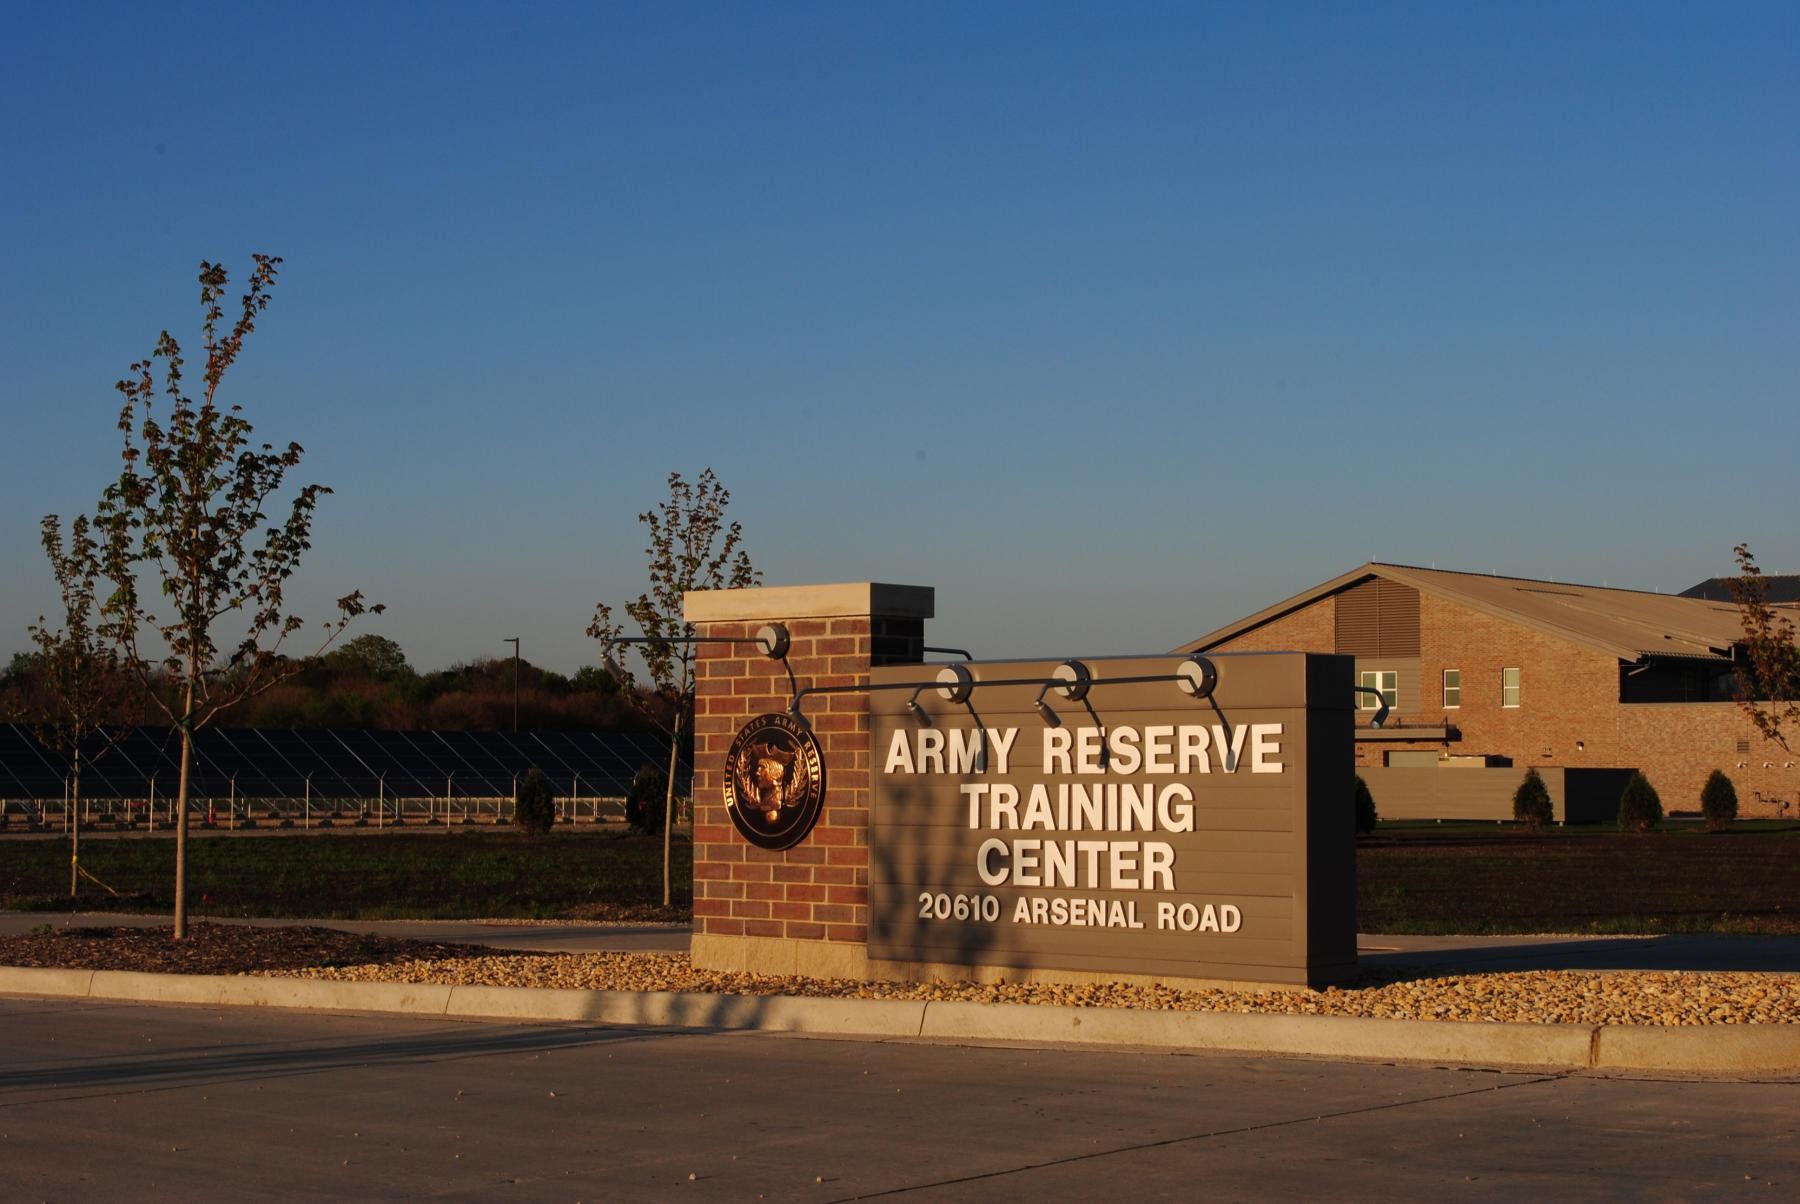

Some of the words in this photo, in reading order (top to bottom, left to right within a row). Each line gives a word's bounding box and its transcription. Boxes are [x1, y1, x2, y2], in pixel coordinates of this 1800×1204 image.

[725, 754, 735, 807] UNITED
[735, 716, 768, 747] STATES
[774, 716, 803, 737] ARMY
[804, 740, 819, 800] RESERVE
[884, 728, 1018, 774] ARMY
[1043, 724, 1284, 774] RESERVE
[960, 782, 1195, 832] TRAINING
[977, 838, 1176, 890] CENTER
[918, 892, 999, 921] 20610
[1013, 897, 1144, 929] ARSENAL
[1158, 902, 1242, 933] ROAD
